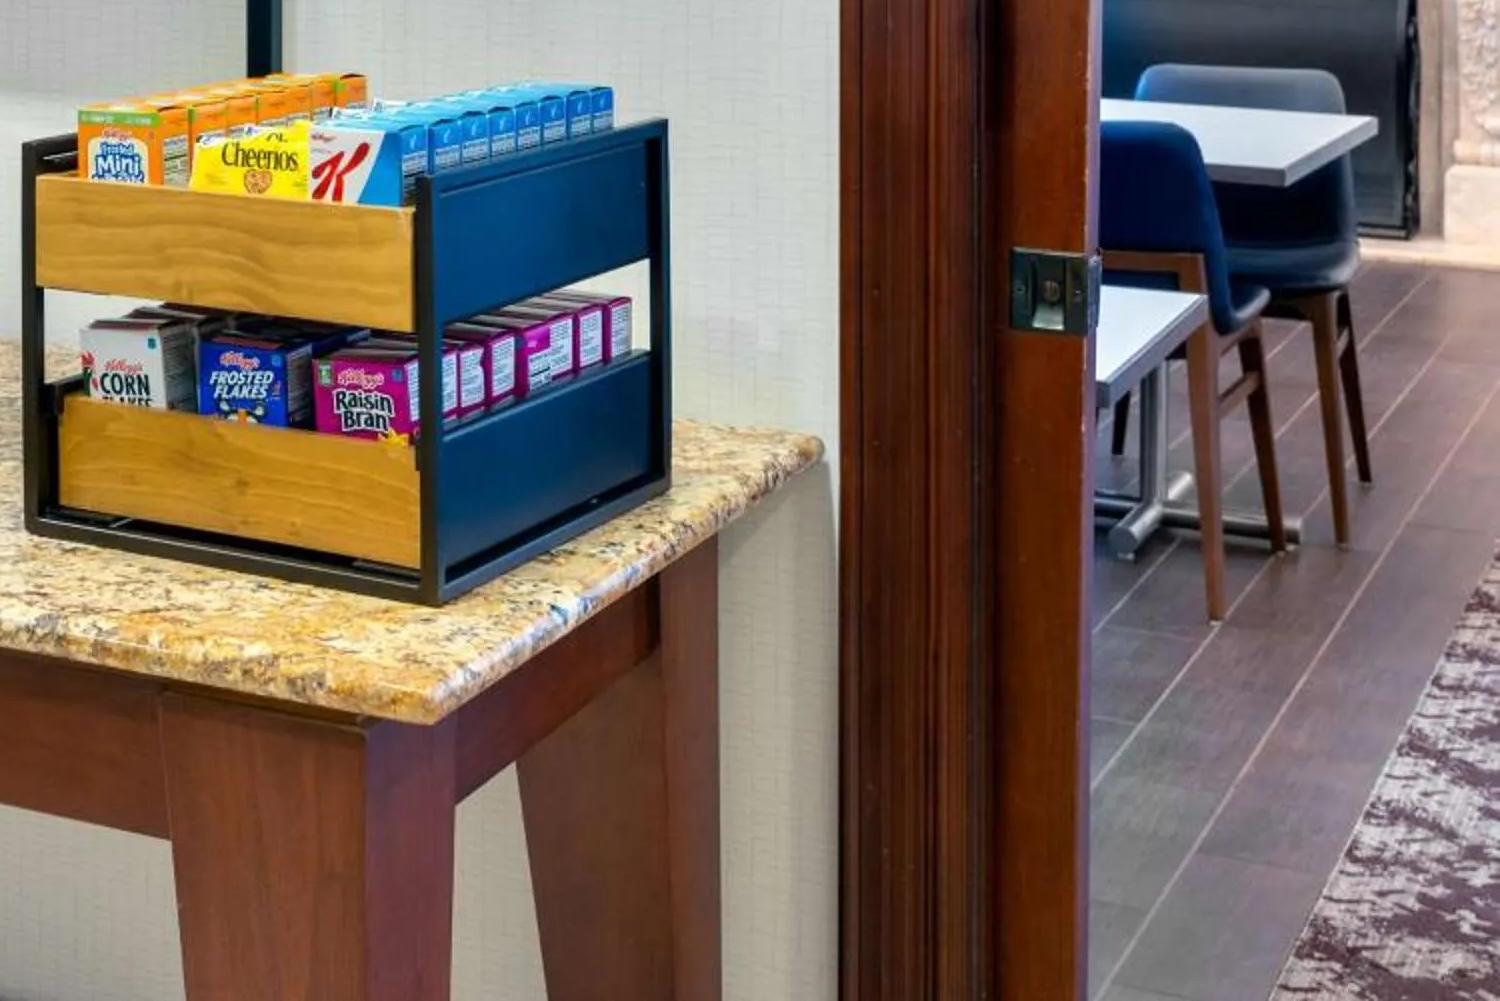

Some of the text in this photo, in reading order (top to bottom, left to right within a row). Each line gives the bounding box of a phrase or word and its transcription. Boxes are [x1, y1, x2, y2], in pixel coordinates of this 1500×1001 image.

[95, 153, 142, 177] Mini
[221, 141, 299, 172] Cheerios
[311, 141, 371, 203] K
[100, 372, 151, 396] CORN
[209, 370, 274, 386] FROSTED
[213, 384, 268, 399] FLAKES
[334, 390, 393, 416] Raisin
[343, 410, 389, 432] Bran
